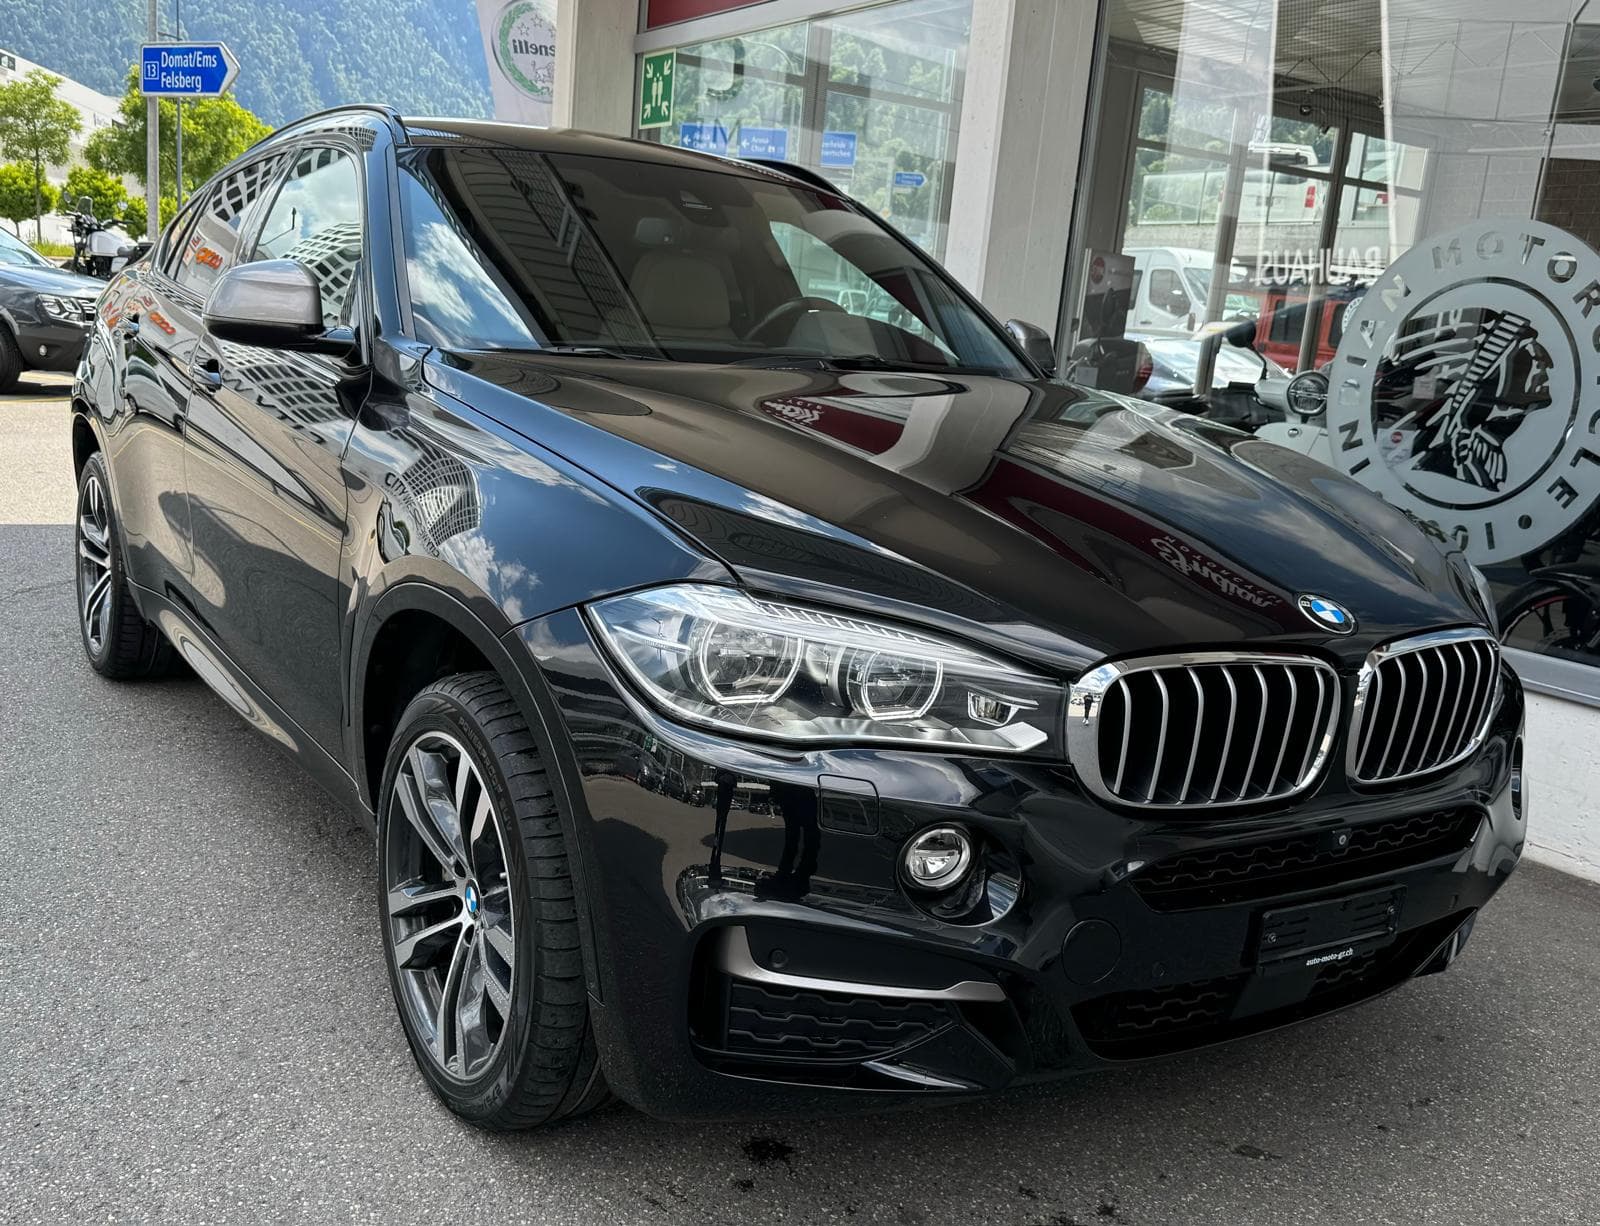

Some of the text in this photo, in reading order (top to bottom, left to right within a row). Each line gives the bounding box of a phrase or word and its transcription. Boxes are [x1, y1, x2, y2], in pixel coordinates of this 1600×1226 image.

[161, 51, 217, 68] Domat/Ems
[147, 64, 156, 77] 13
[161, 71, 202, 93] Felsberg
[1338, 274, 1412, 476] INDIAN
[1306, 947, 1354, 966] auto-moto-gr.ch
